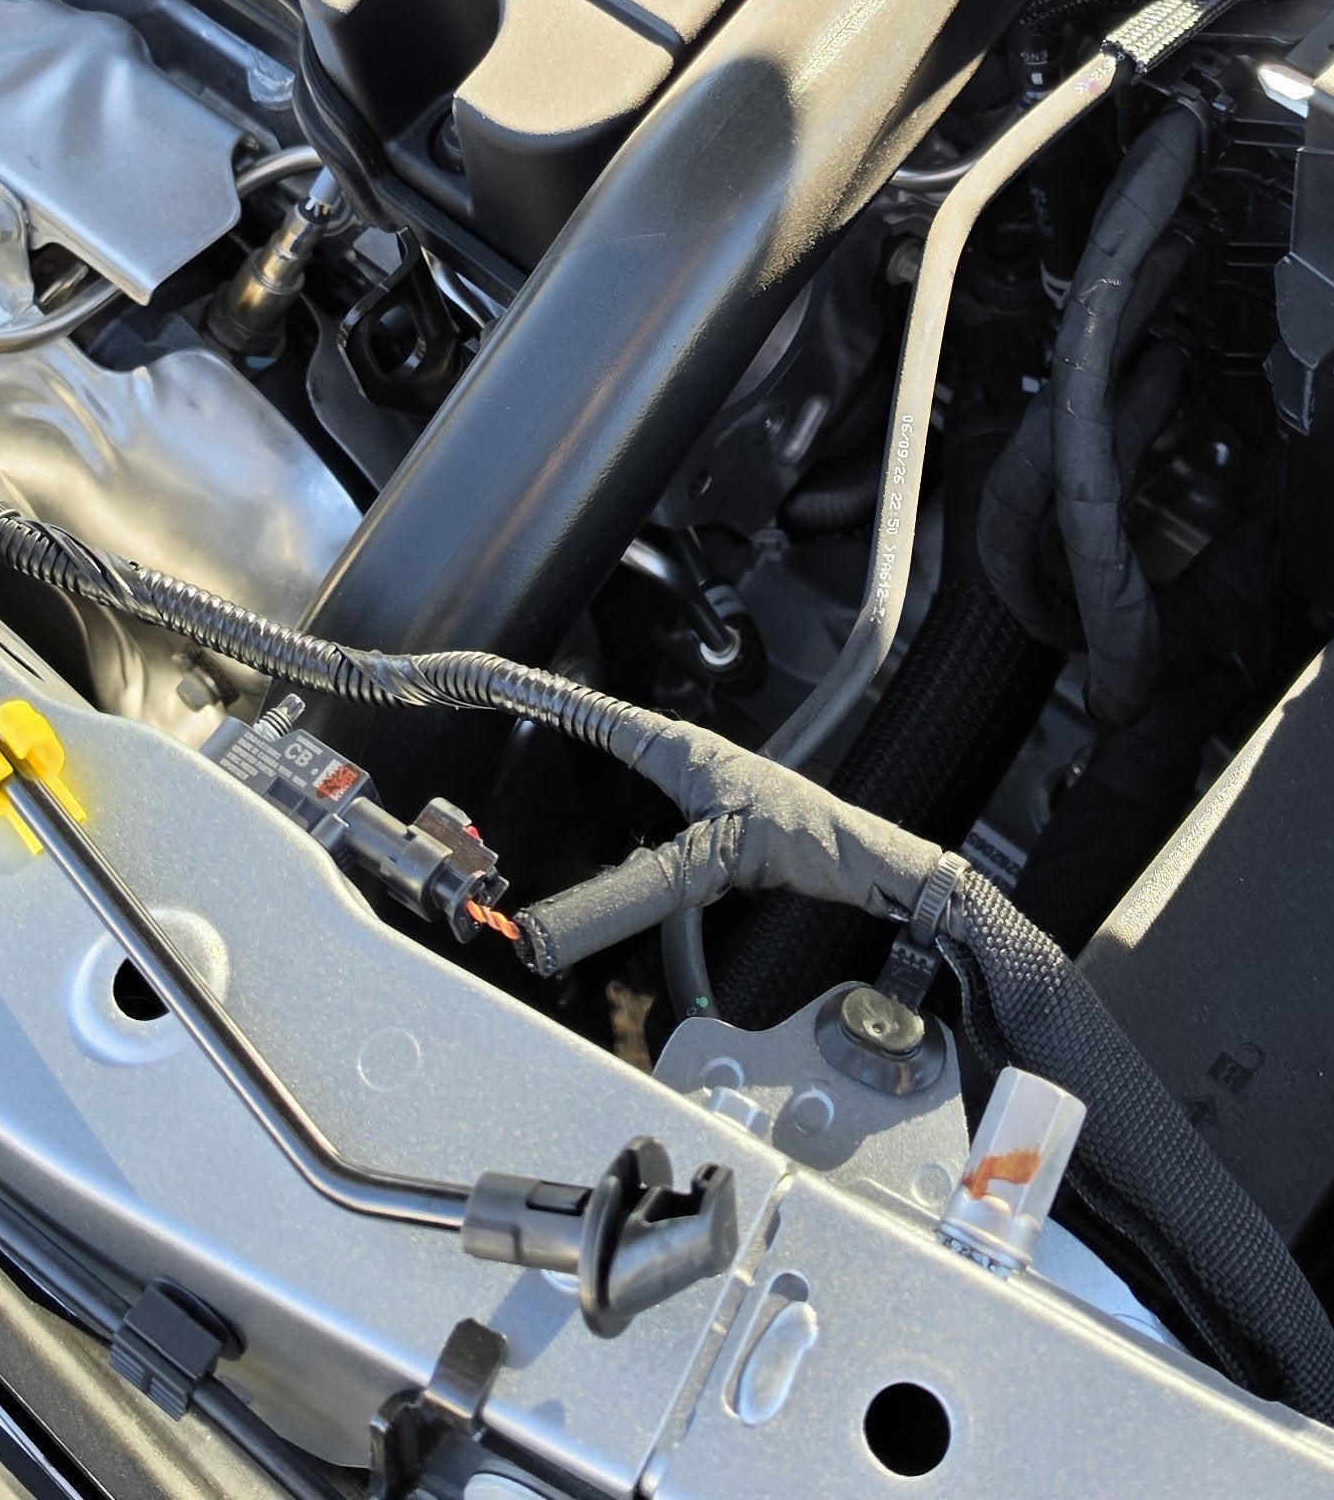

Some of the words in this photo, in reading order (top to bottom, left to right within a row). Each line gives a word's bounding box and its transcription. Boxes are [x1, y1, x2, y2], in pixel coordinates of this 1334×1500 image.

[893, 414, 914, 486] 06/09/26
[886, 494, 903, 536] 22:50
[285, 742, 313, 767] CB
